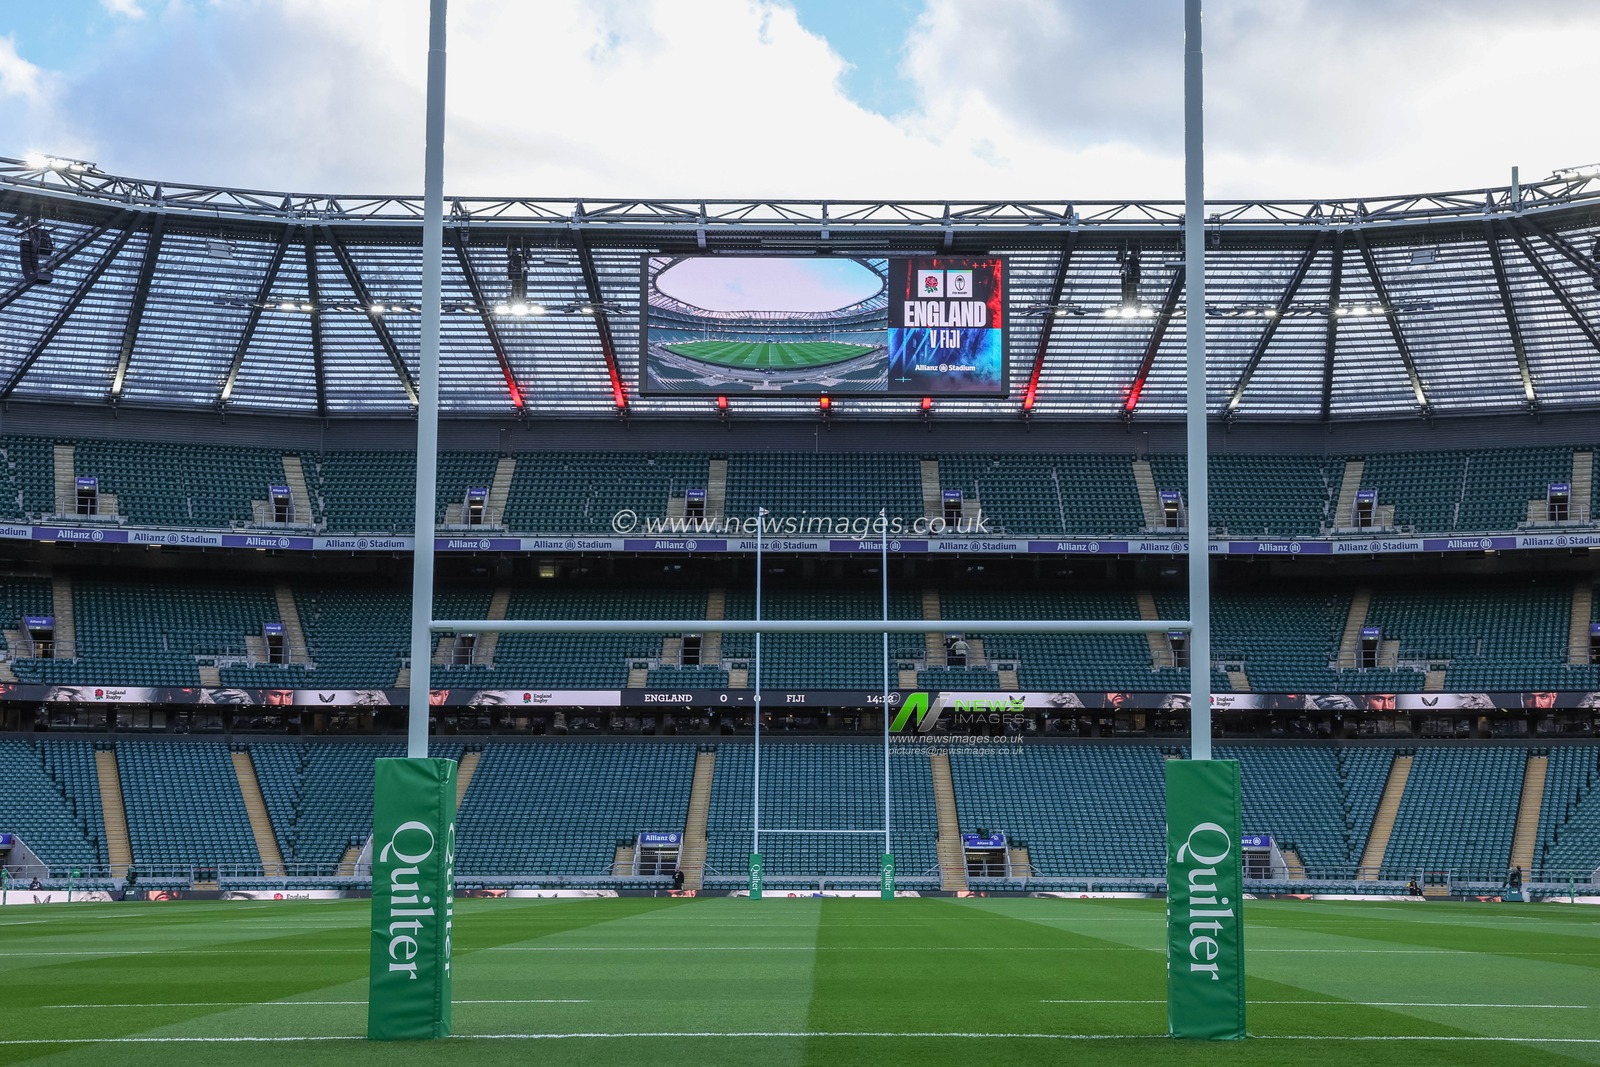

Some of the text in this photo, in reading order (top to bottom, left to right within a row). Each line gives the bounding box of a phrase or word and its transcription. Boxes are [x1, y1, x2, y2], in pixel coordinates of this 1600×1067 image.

[904, 301, 986, 327] ENGLAND
[930, 330, 960, 348] V FIJI
[0, 527, 26, 536] adium
[57, 530, 90, 539] Allianz
[134, 533, 217, 544] Allianz Stadium
[246, 537, 276, 546] Allianz
[1522, 536, 1600, 546] Allianz Stadiu
[326, 540, 404, 548] Allianz Stadium
[448, 540, 478, 548] Allianz
[534, 540, 612, 549] Allianz Stadium
[655, 541, 684, 549] Allianz
[783, 542, 817, 550] Stadium
[939, 542, 1016, 550] Allianz Stadium
[1140, 543, 1169, 551] Allianz
[1382, 542, 1418, 550] Stadium
[1448, 540, 1478, 548] Allianz
[644, 694, 692, 702] ENGLAND
[750, 864, 760, 891] Quilter
[884, 864, 893, 891] Quilter
[380, 821, 435, 980] Quilter
[1176, 822, 1234, 980] Quilter
